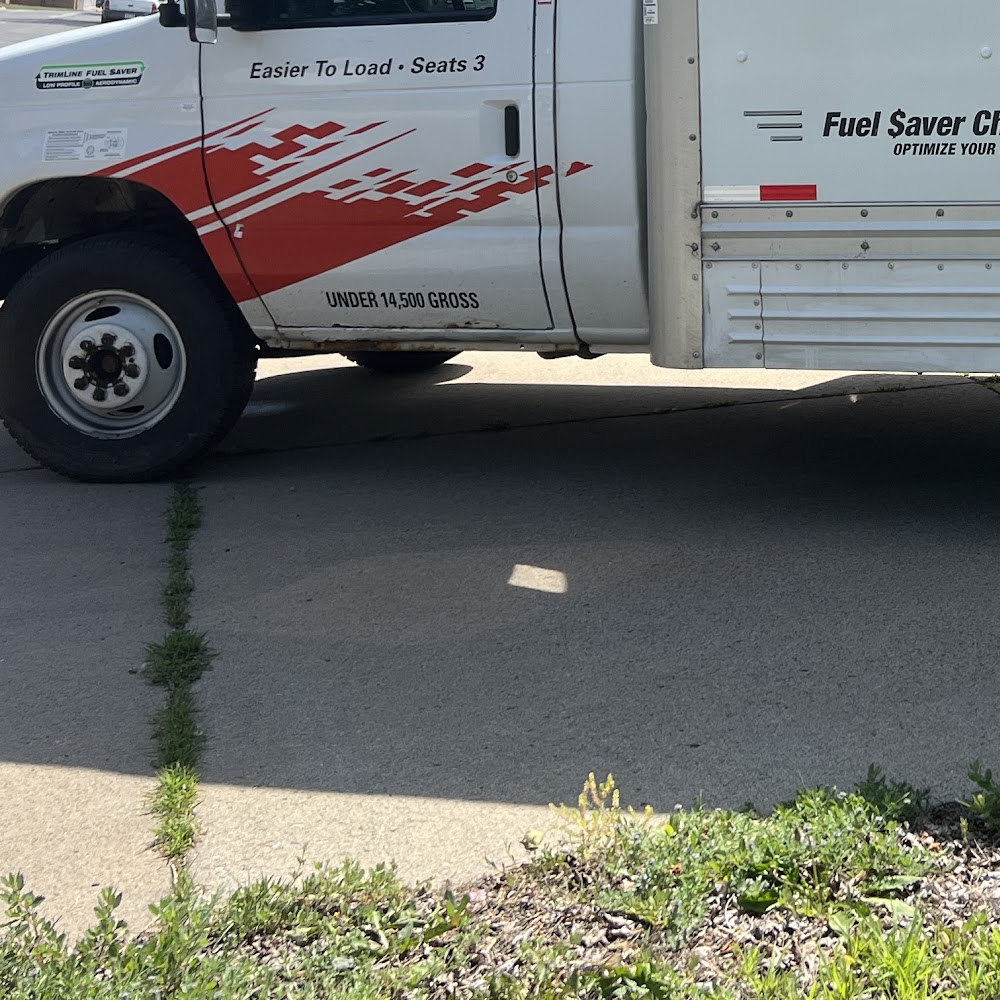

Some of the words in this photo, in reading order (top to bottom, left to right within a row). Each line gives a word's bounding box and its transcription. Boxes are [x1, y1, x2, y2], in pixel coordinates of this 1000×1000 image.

[43, 70, 83, 79] TRIMLINE
[86, 69, 107, 77] FUEL
[109, 67, 138, 76] SAVER
[249, 61, 309, 79] Easier
[315, 60, 337, 77] To
[343, 58, 392, 76] Load
[410, 56, 467, 74] Seats
[473, 54, 486, 72] 3
[822, 110, 881, 137] Fuel
[887, 108, 966, 138] $aver
[893, 143, 956, 156] OPTIMIZE
[960, 142, 995, 155] YOUR
[326, 291, 379, 308] UNDER
[380, 291, 425, 310] 14,500
[428, 291, 480, 309] GROSS
